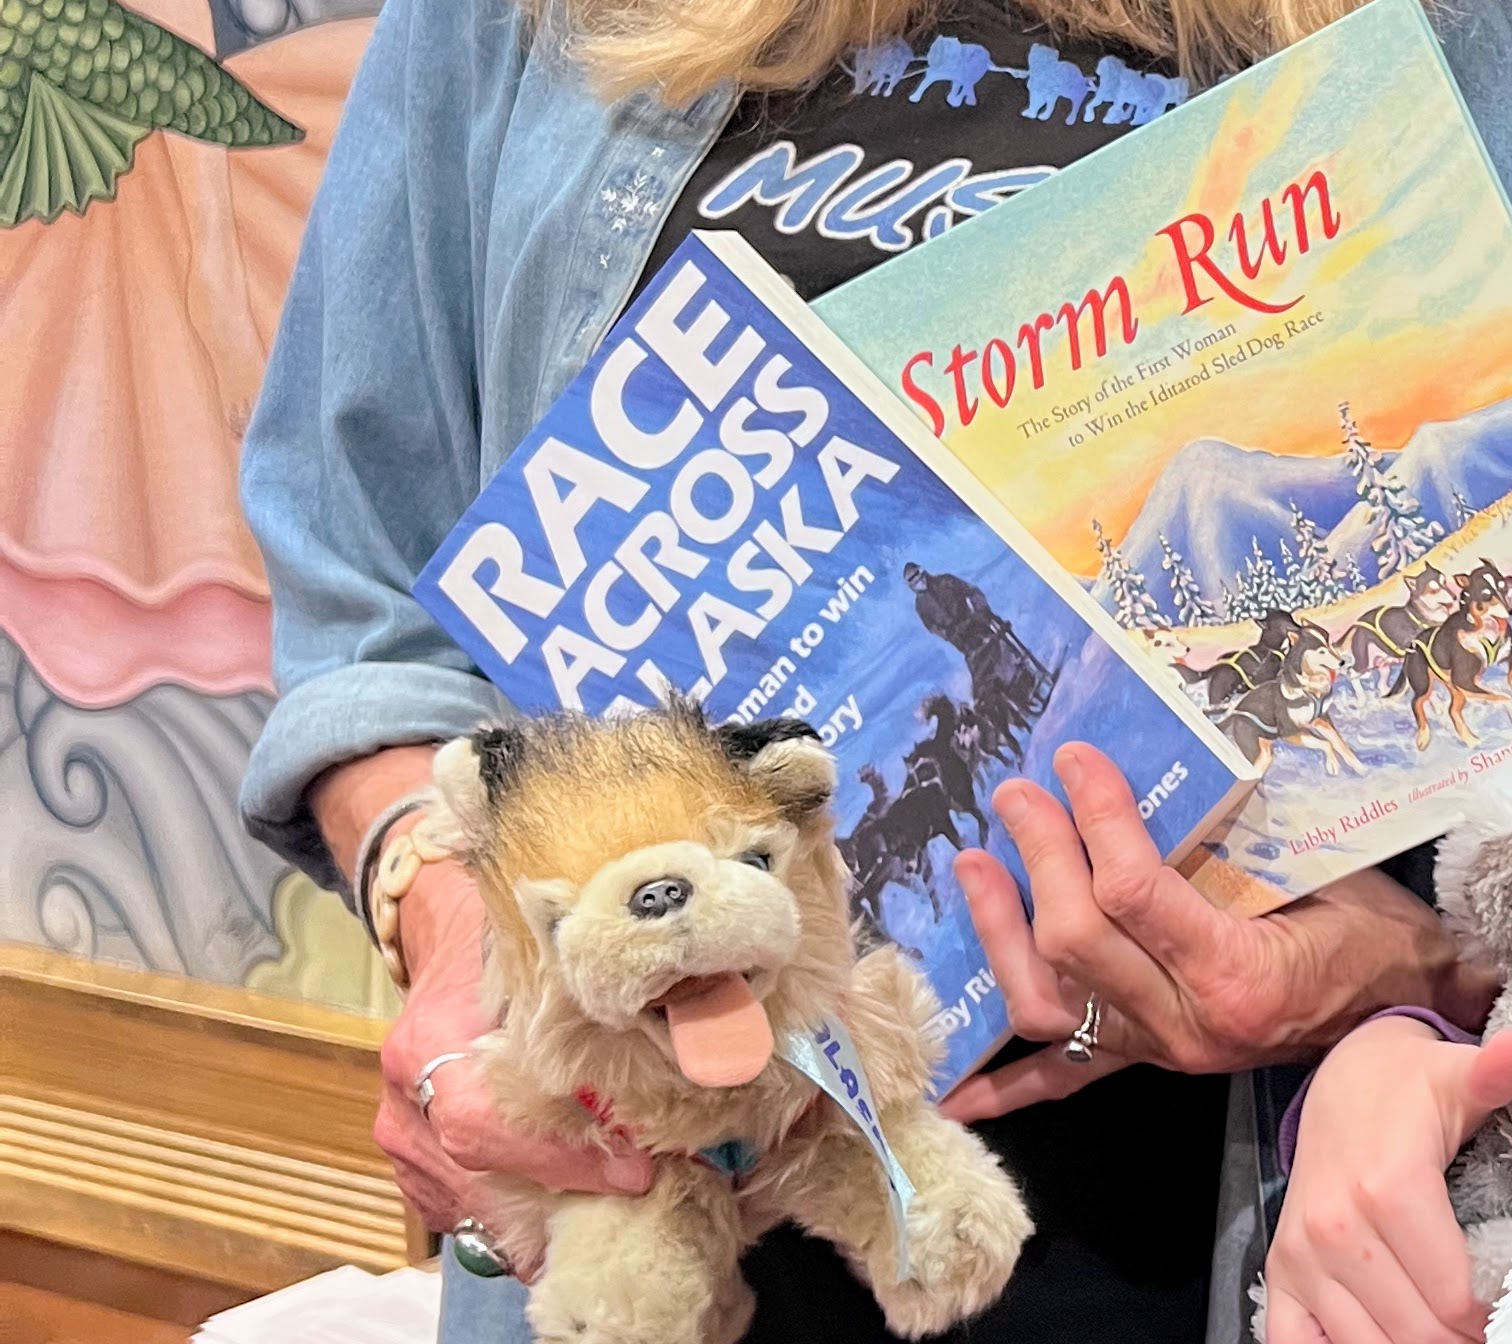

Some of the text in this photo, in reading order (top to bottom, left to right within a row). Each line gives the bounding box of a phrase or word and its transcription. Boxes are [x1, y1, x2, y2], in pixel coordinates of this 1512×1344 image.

[901, 170, 1341, 438] Storm Run
[1017, 323, 1237, 439] The Story of the First Woman
[1068, 310, 1325, 447] to Win the Iditarod Sled Dog Race
[437, 259, 767, 665] RACE
[540, 354, 830, 715] ACROSS
[602, 435, 901, 719] LASKA
[790, 622, 825, 658] to
[819, 565, 875, 623] win
[1136, 760, 1189, 821] ones
[1288, 823, 1338, 856] Libby
[1339, 798, 1400, 834] Riddles
[1406, 772, 1457, 804] Illustrated
[1457, 768, 1470, 784] by
